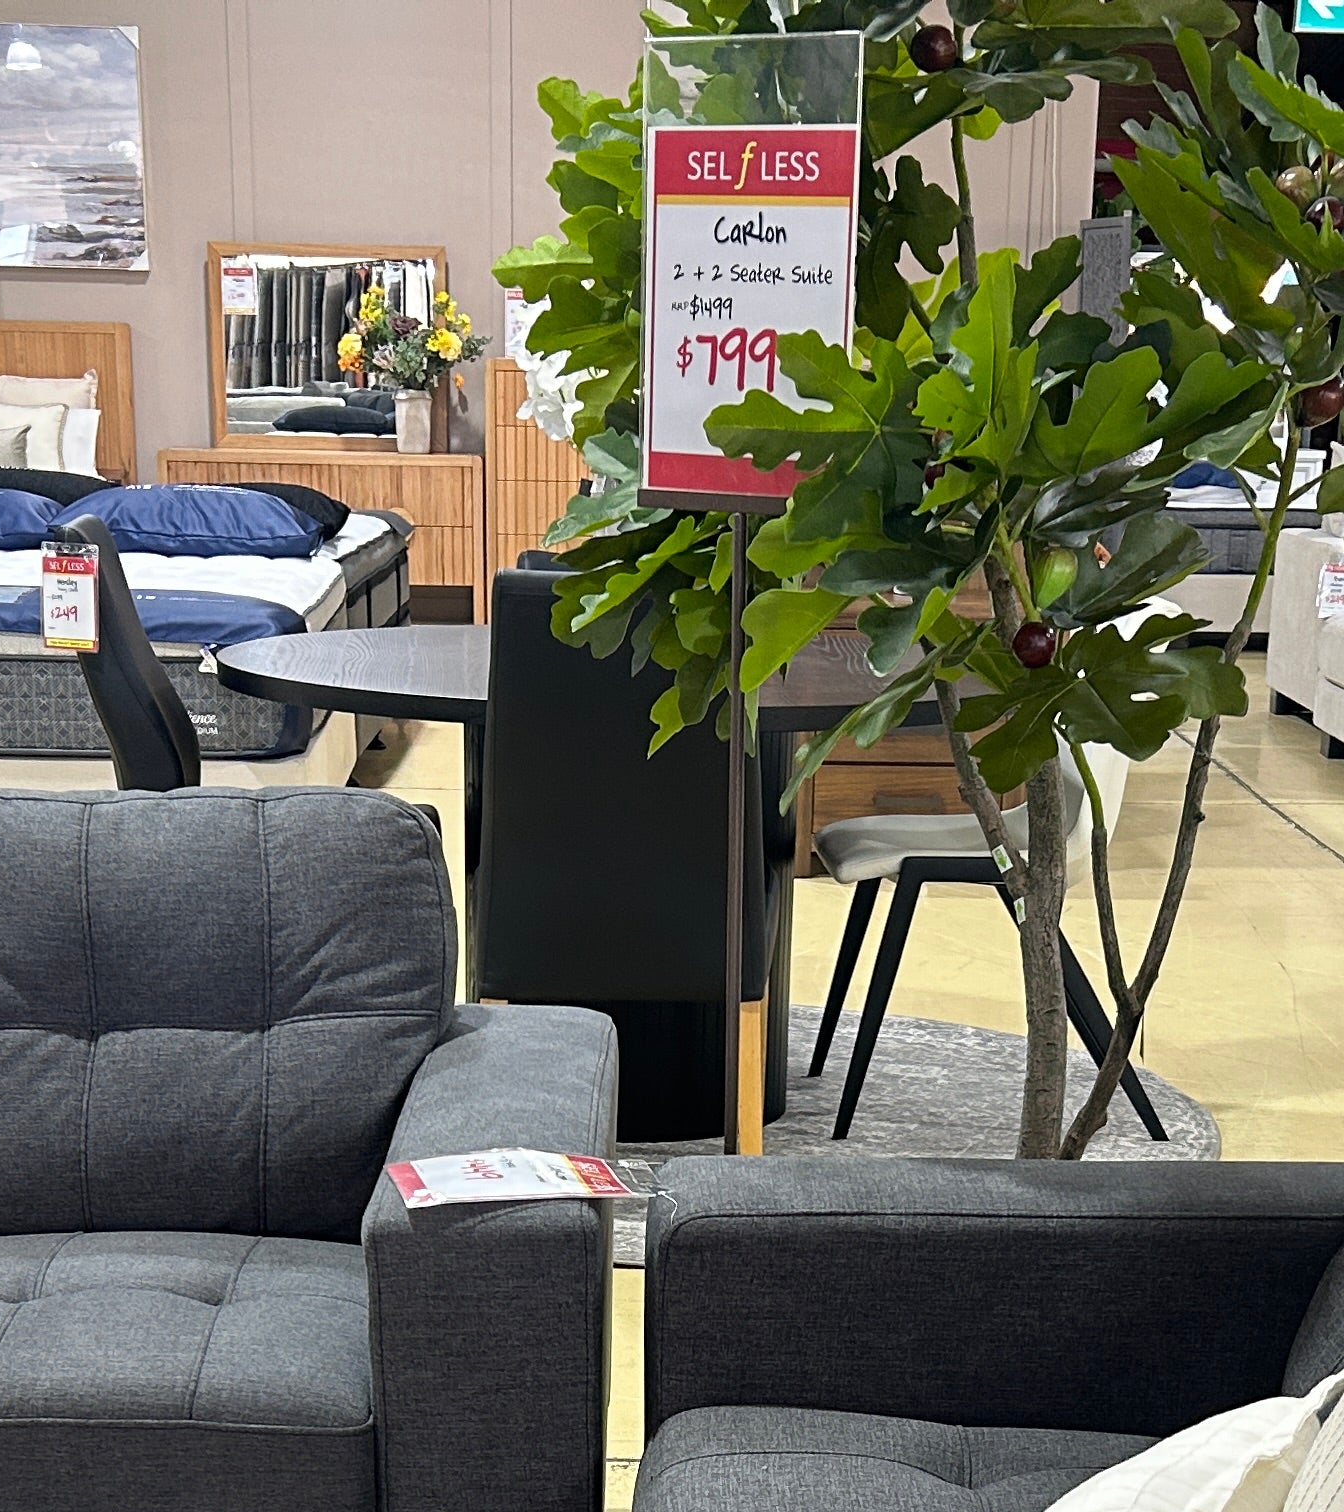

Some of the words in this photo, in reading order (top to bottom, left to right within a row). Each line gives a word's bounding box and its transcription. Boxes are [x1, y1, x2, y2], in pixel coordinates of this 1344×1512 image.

[673, 264, 684, 282] 2
[693, 267, 705, 282] +
[712, 265, 724, 282] 2
[791, 266, 833, 285] Suite
[689, 294, 733, 321] $1499
[676, 327, 778, 392] $799
[51, 606, 78, 622] $249
